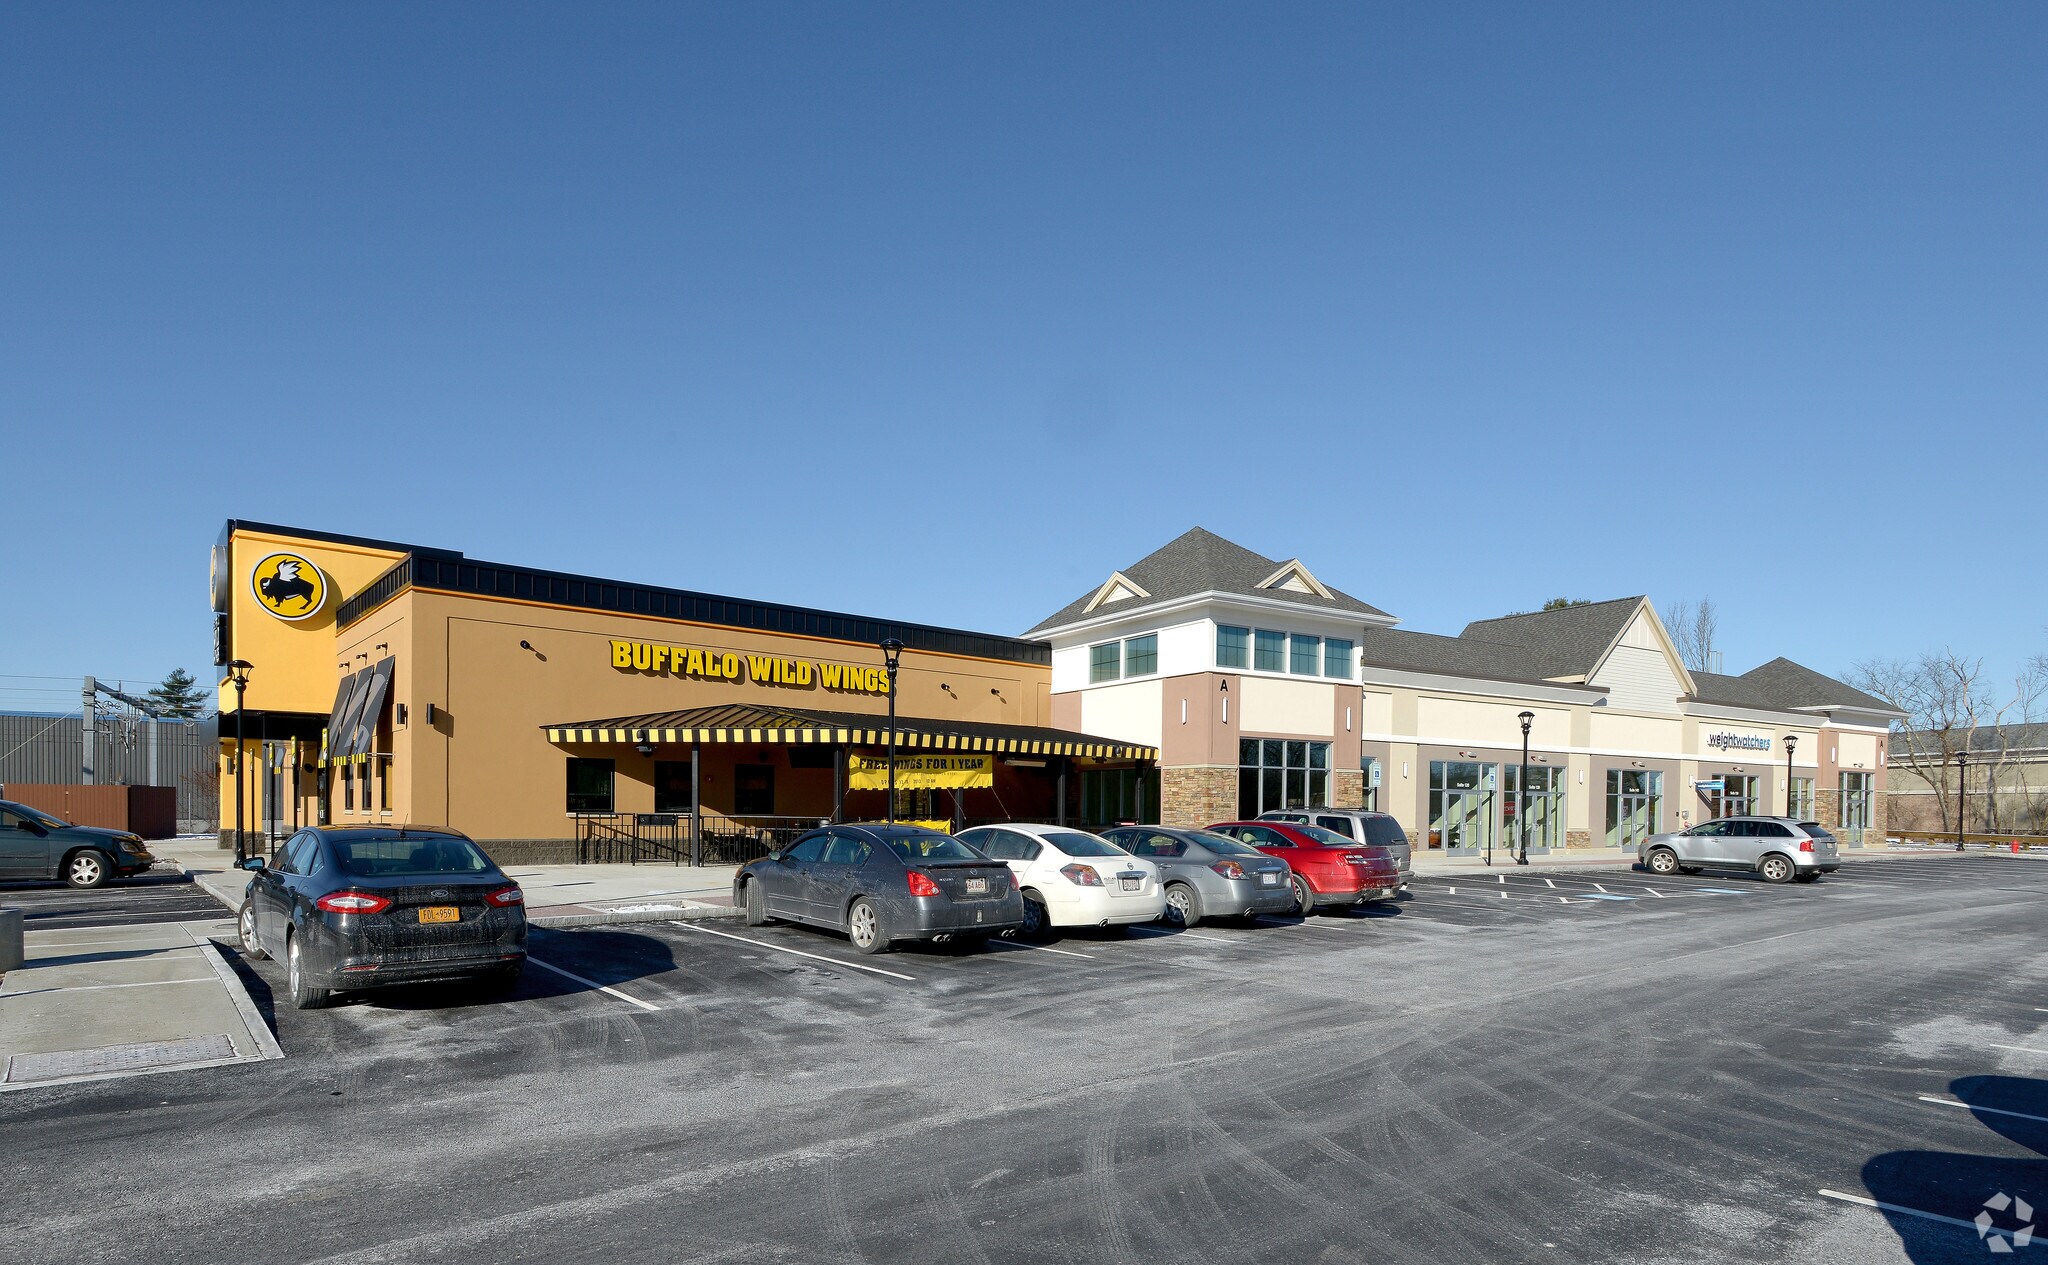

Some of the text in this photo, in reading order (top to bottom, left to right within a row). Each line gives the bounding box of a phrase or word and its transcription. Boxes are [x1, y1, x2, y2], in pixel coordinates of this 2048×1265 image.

[609, 640, 890, 694] BUFFALO WILD WINGS
[1220, 679, 1228, 691] A
[1709, 731, 1771, 749] weightwatchers
[859, 758, 888, 770] FREE
[926, 758, 947, 770] FOR
[958, 758, 984, 770] YEAR
